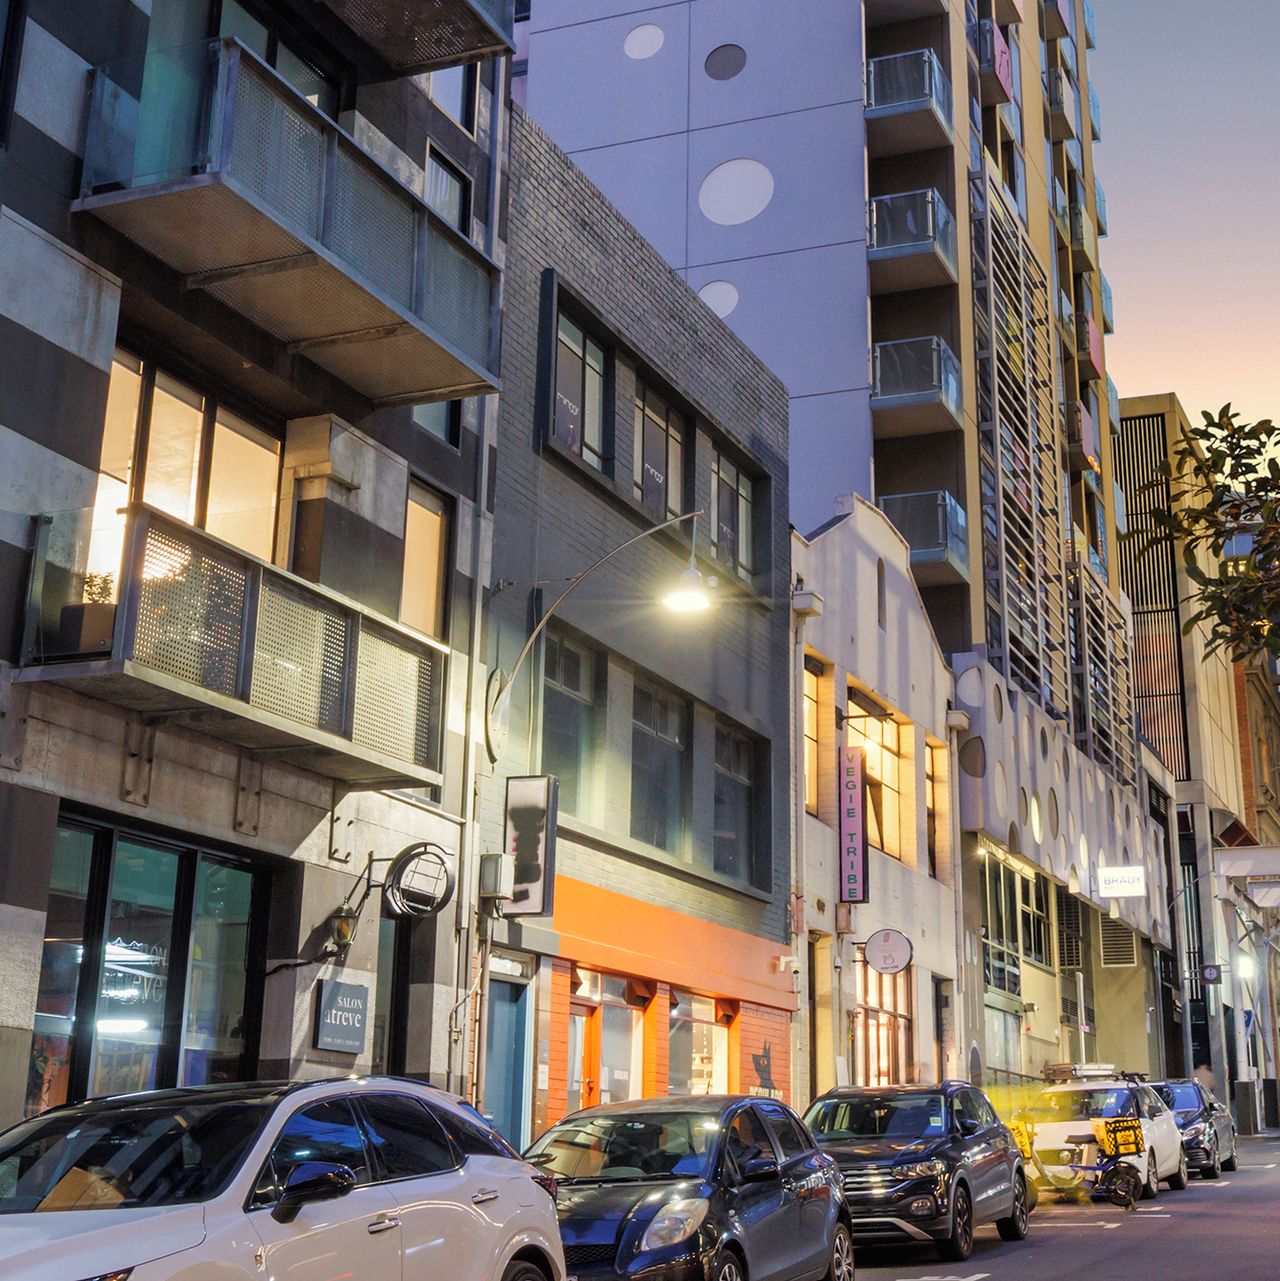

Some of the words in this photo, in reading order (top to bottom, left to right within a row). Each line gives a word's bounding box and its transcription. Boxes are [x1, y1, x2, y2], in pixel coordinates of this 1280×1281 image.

[846, 754, 857, 819] VEGIE
[846, 832, 858, 898] TRIBE
[324, 1008, 362, 1028] atreve
[336, 995, 363, 1010] SALON
